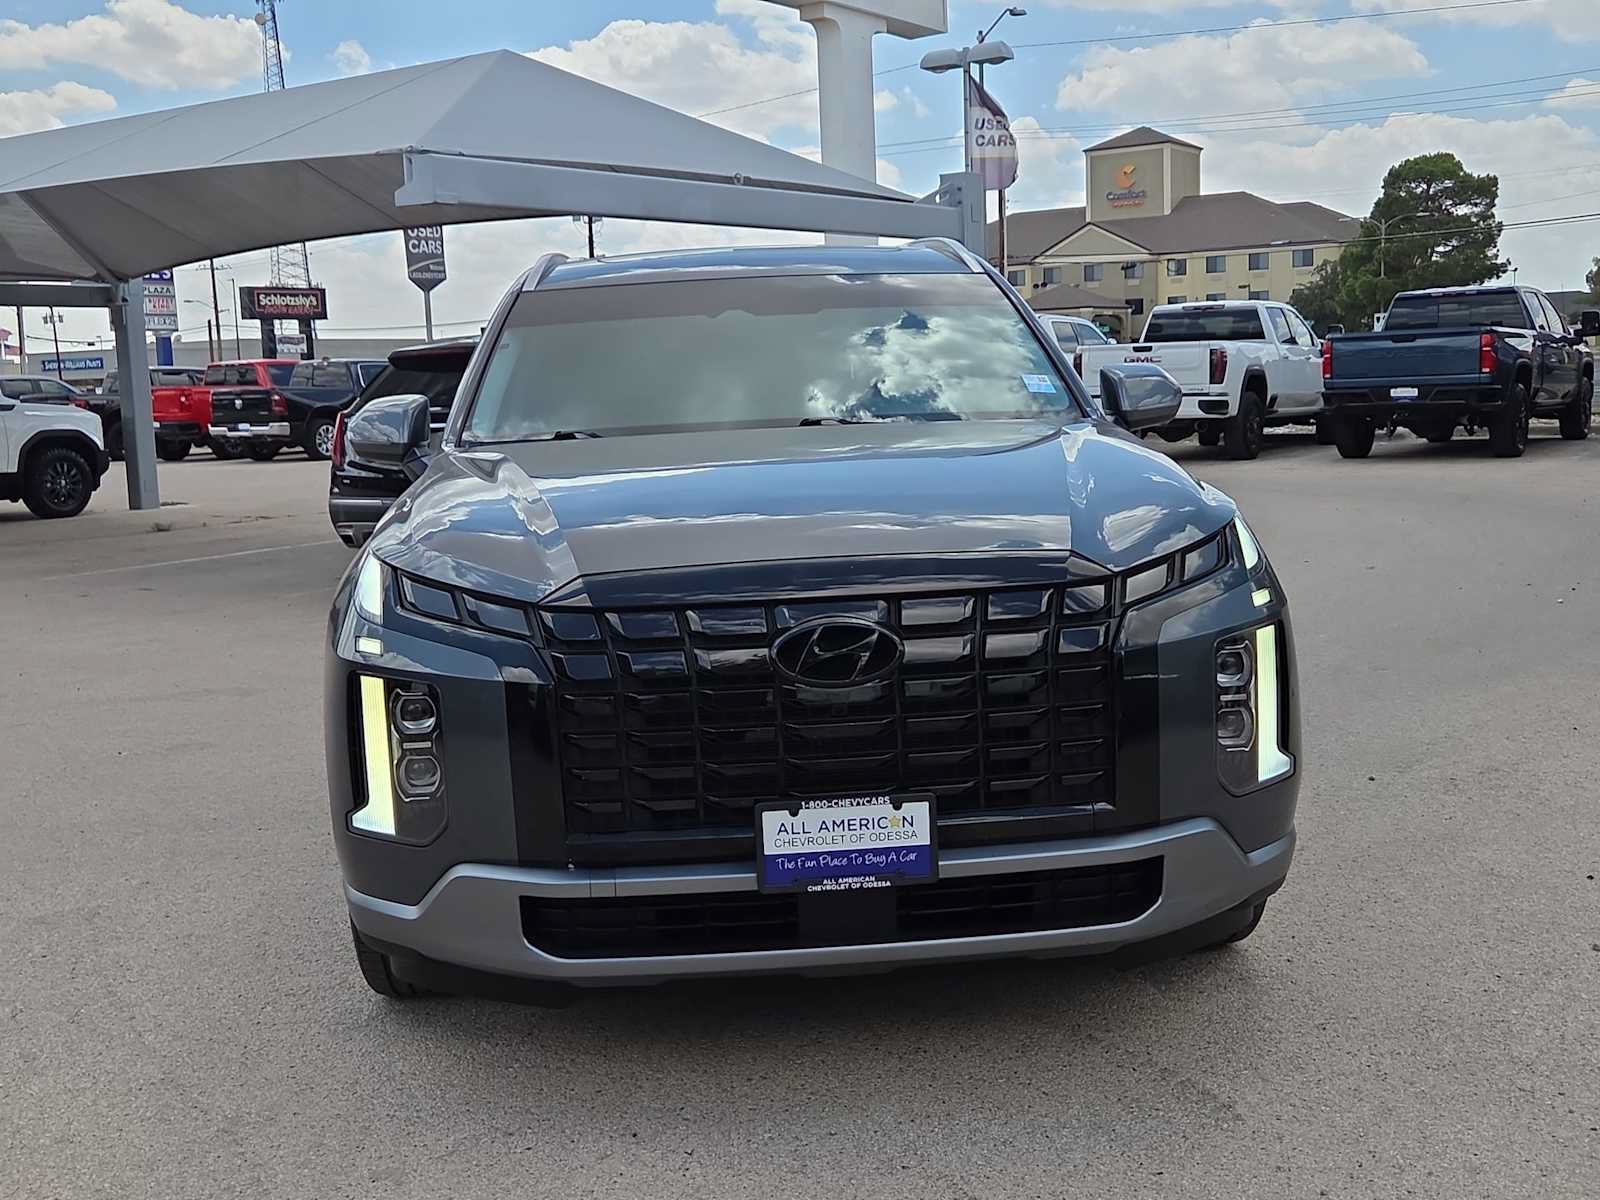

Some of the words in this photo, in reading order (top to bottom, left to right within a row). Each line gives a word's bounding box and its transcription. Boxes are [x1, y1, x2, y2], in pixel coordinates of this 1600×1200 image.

[975, 134, 1016, 147] CARS
[407, 226, 441, 237] USED
[408, 240, 443, 254] CARS
[259, 293, 318, 308] Schlotzsky's
[801, 796, 891, 809] 1-800-CHEVYCARS
[777, 821, 812, 836] ALL
[774, 834, 847, 848] CHEVROLET
[850, 833, 866, 843] OF
[869, 830, 918, 842] ODESSA
[775, 857, 796, 870] The
[797, 857, 817, 869] Fun
[819, 854, 848, 868] Place
[849, 853, 863, 865] To
[864, 852, 886, 867] Buy
[887, 851, 898, 863] A
[899, 850, 918, 862] Car
[807, 883, 850, 892] CHEVROLET
[862, 880, 891, 888] ODESSA
[838, 876, 876, 884] AMERICAN
